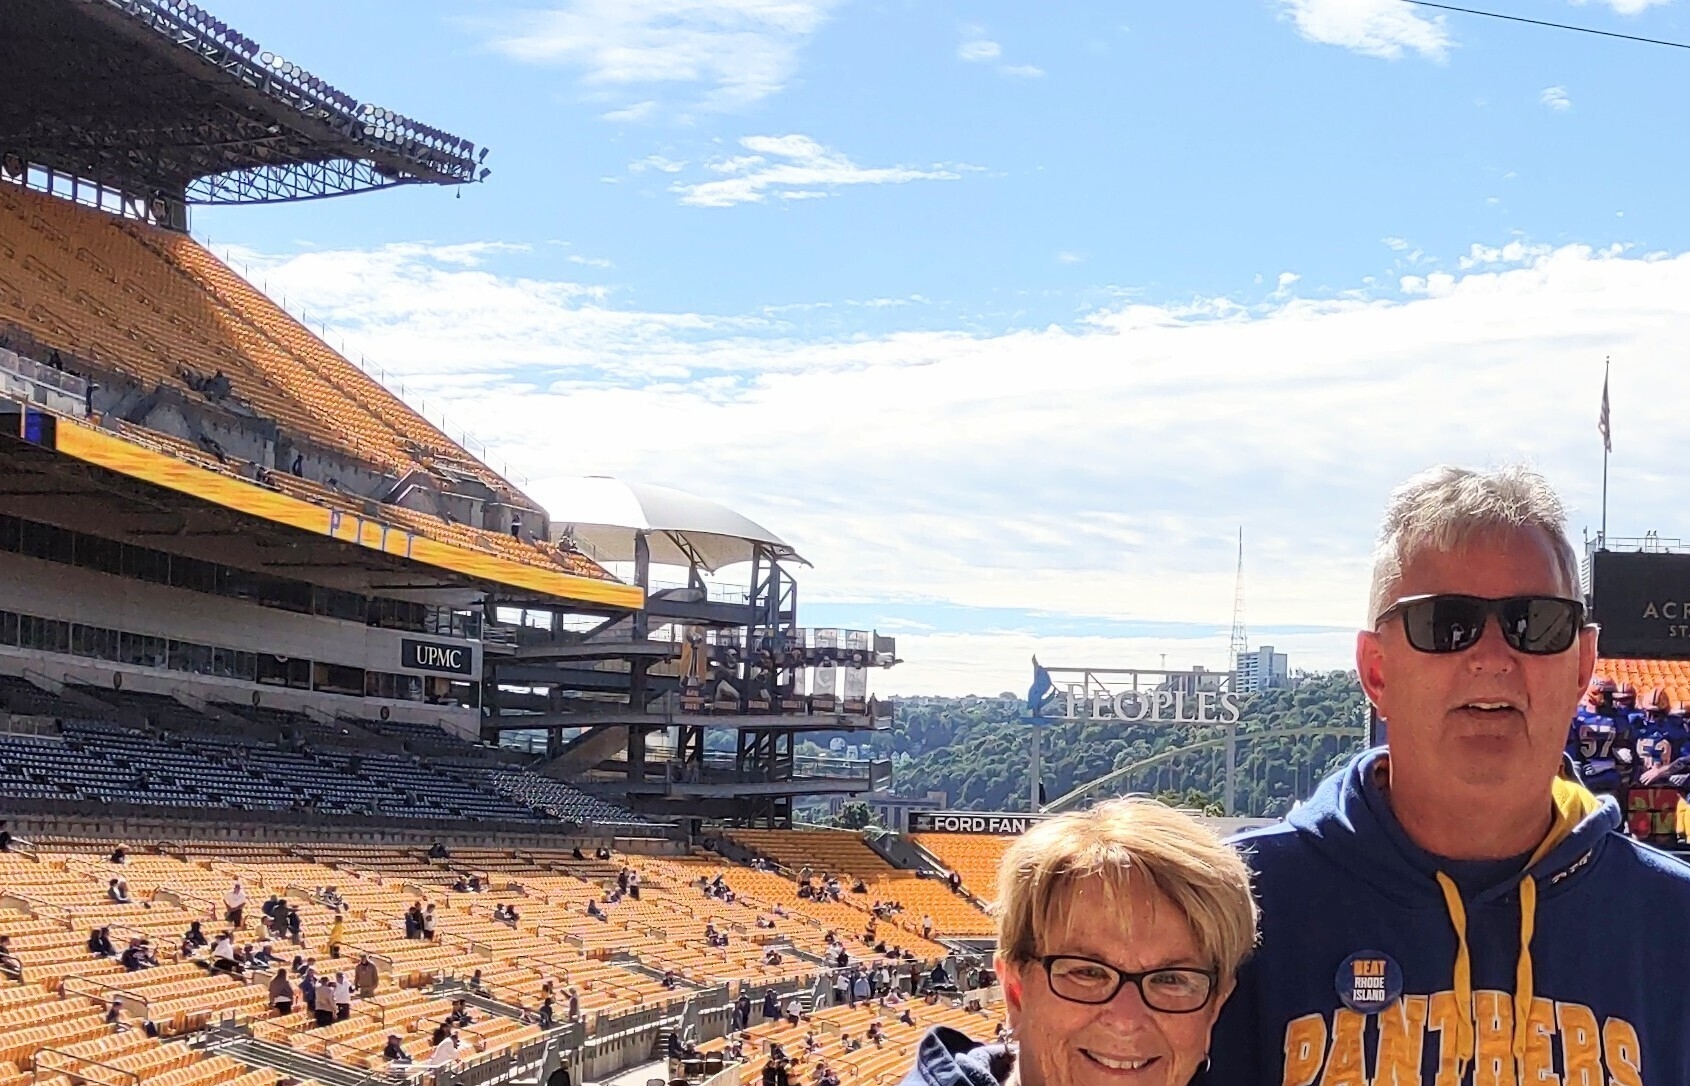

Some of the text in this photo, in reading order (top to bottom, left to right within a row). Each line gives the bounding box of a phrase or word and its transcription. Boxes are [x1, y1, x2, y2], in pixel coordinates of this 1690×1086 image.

[416, 644, 462, 669] UPMC
[1065, 683, 1240, 724] PEOPLES
[933, 817, 1027, 834] FORD FAN
[1353, 960, 1386, 977] BEAT
[1354, 976, 1385, 989] RHODE
[1353, 989, 1386, 1002] ISLAND
